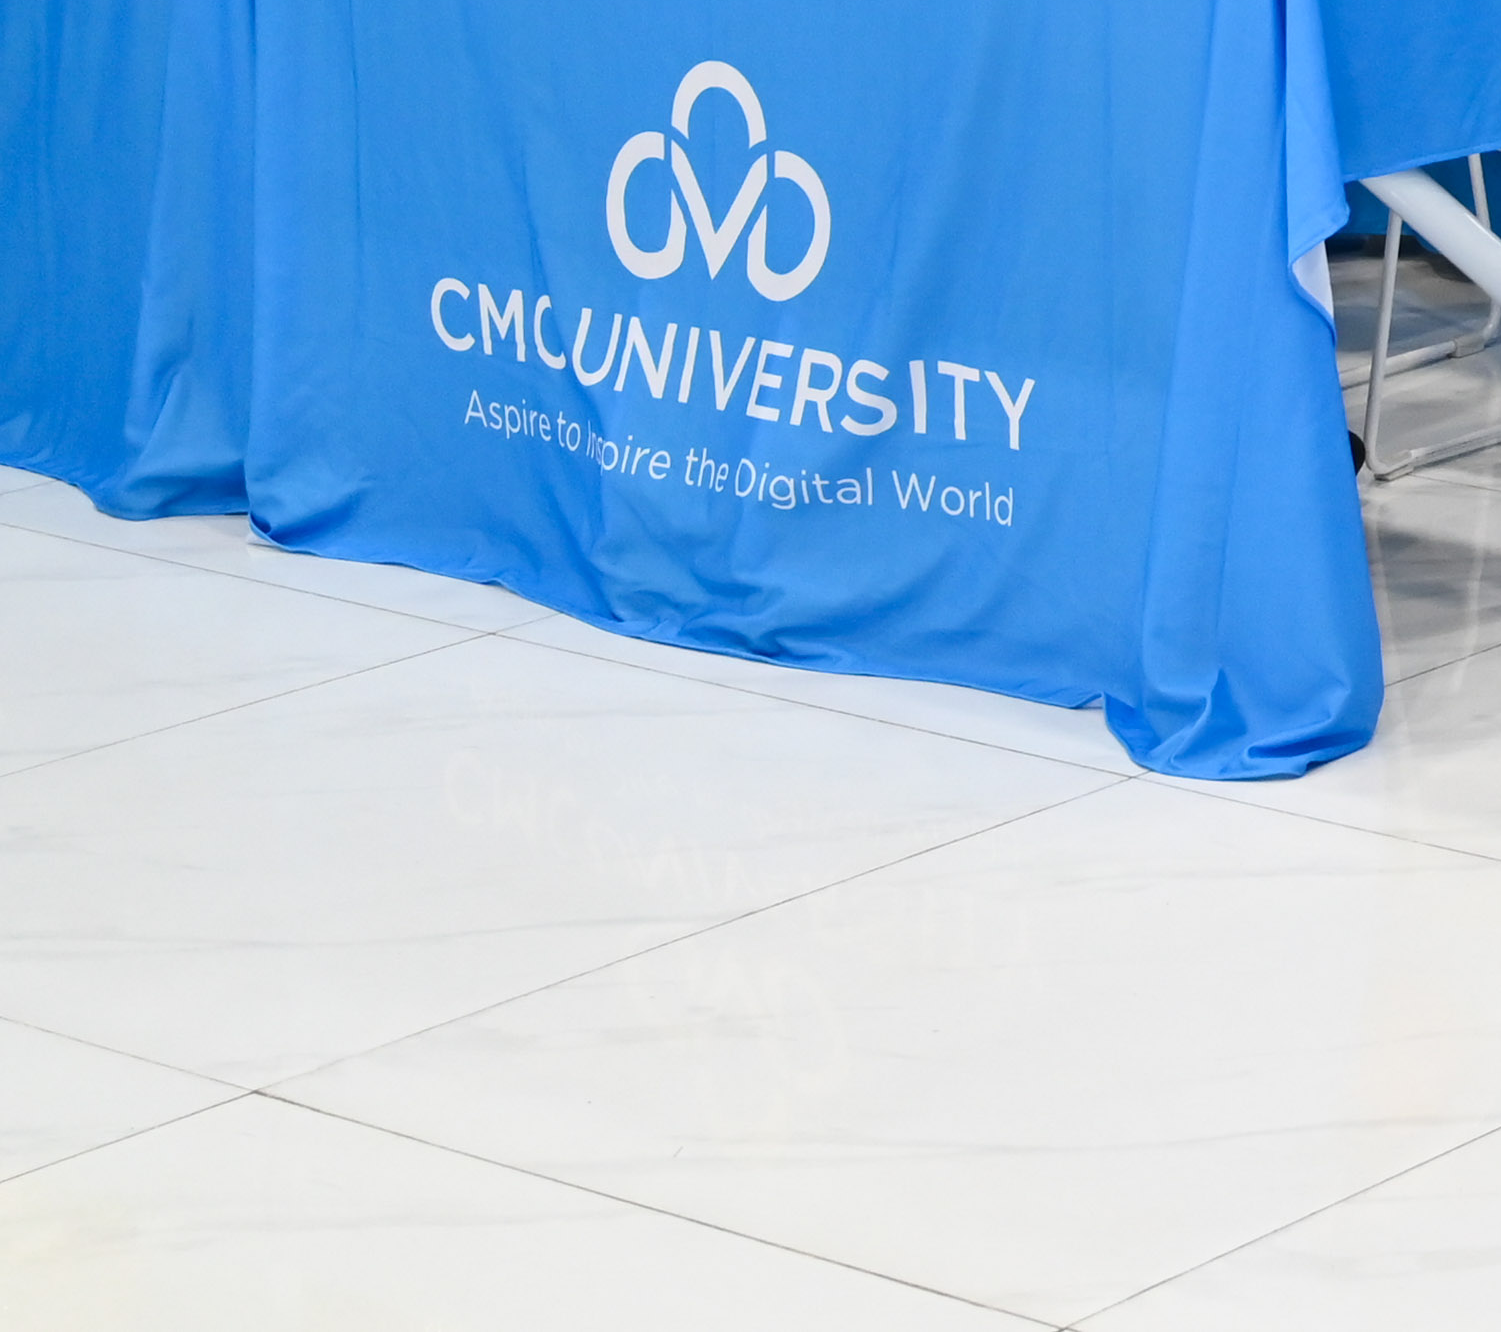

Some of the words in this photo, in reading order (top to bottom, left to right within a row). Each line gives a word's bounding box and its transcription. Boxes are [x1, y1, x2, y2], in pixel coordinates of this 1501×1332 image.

[430, 277, 566, 370] CMC
[571, 307, 1036, 452] UNIVERSITY
[464, 389, 553, 454] Aspire
[555, 409, 582, 452] to
[684, 446, 730, 493] the
[734, 456, 874, 511] Digital
[892, 470, 1015, 527] World
